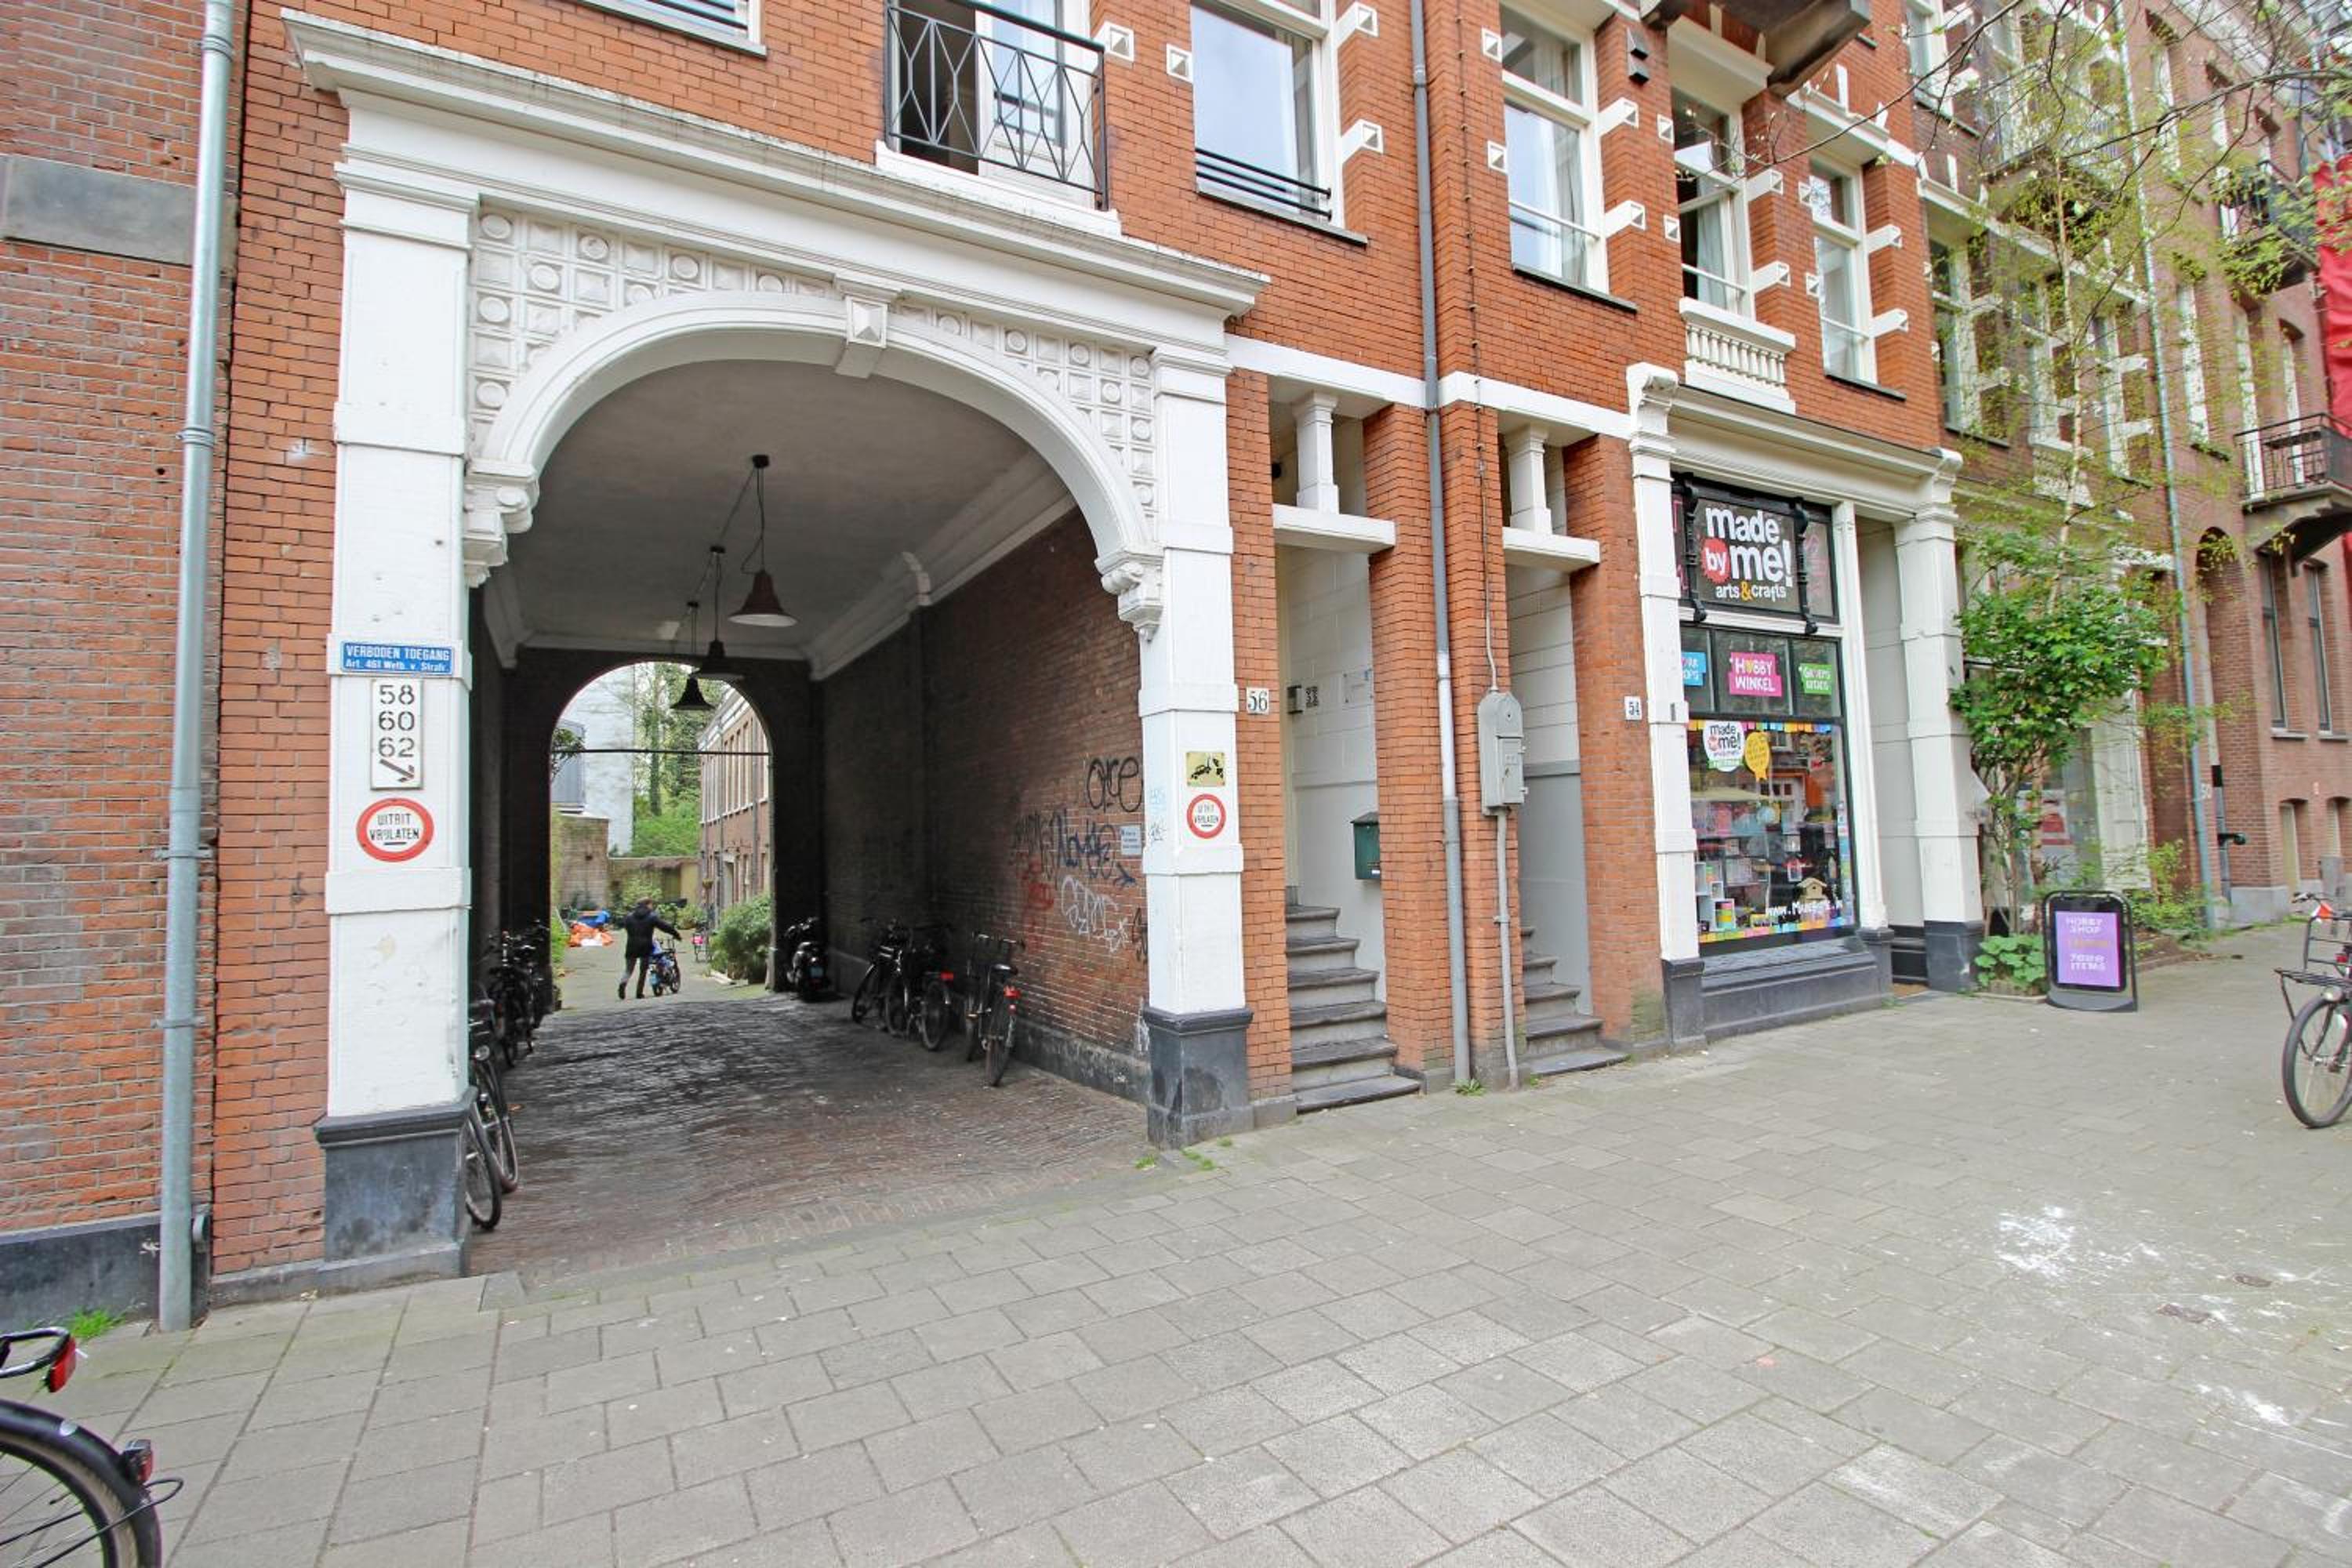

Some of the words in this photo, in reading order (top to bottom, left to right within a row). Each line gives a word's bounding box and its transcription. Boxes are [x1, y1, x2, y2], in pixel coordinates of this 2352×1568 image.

[1705, 507, 1780, 544] made
[1704, 547, 1727, 575] by
[1730, 539, 1793, 587] me!
[346, 645, 401, 659] VERBODEN
[405, 648, 449, 661] TOEGANG
[1735, 676, 1776, 692] WINKEL
[379, 684, 414, 705] 58
[1248, 690, 1268, 711] 56
[379, 711, 414, 731] 60
[1710, 722, 1736, 735] made
[379, 737, 414, 757] 62
[1719, 732, 1741, 750] me!
